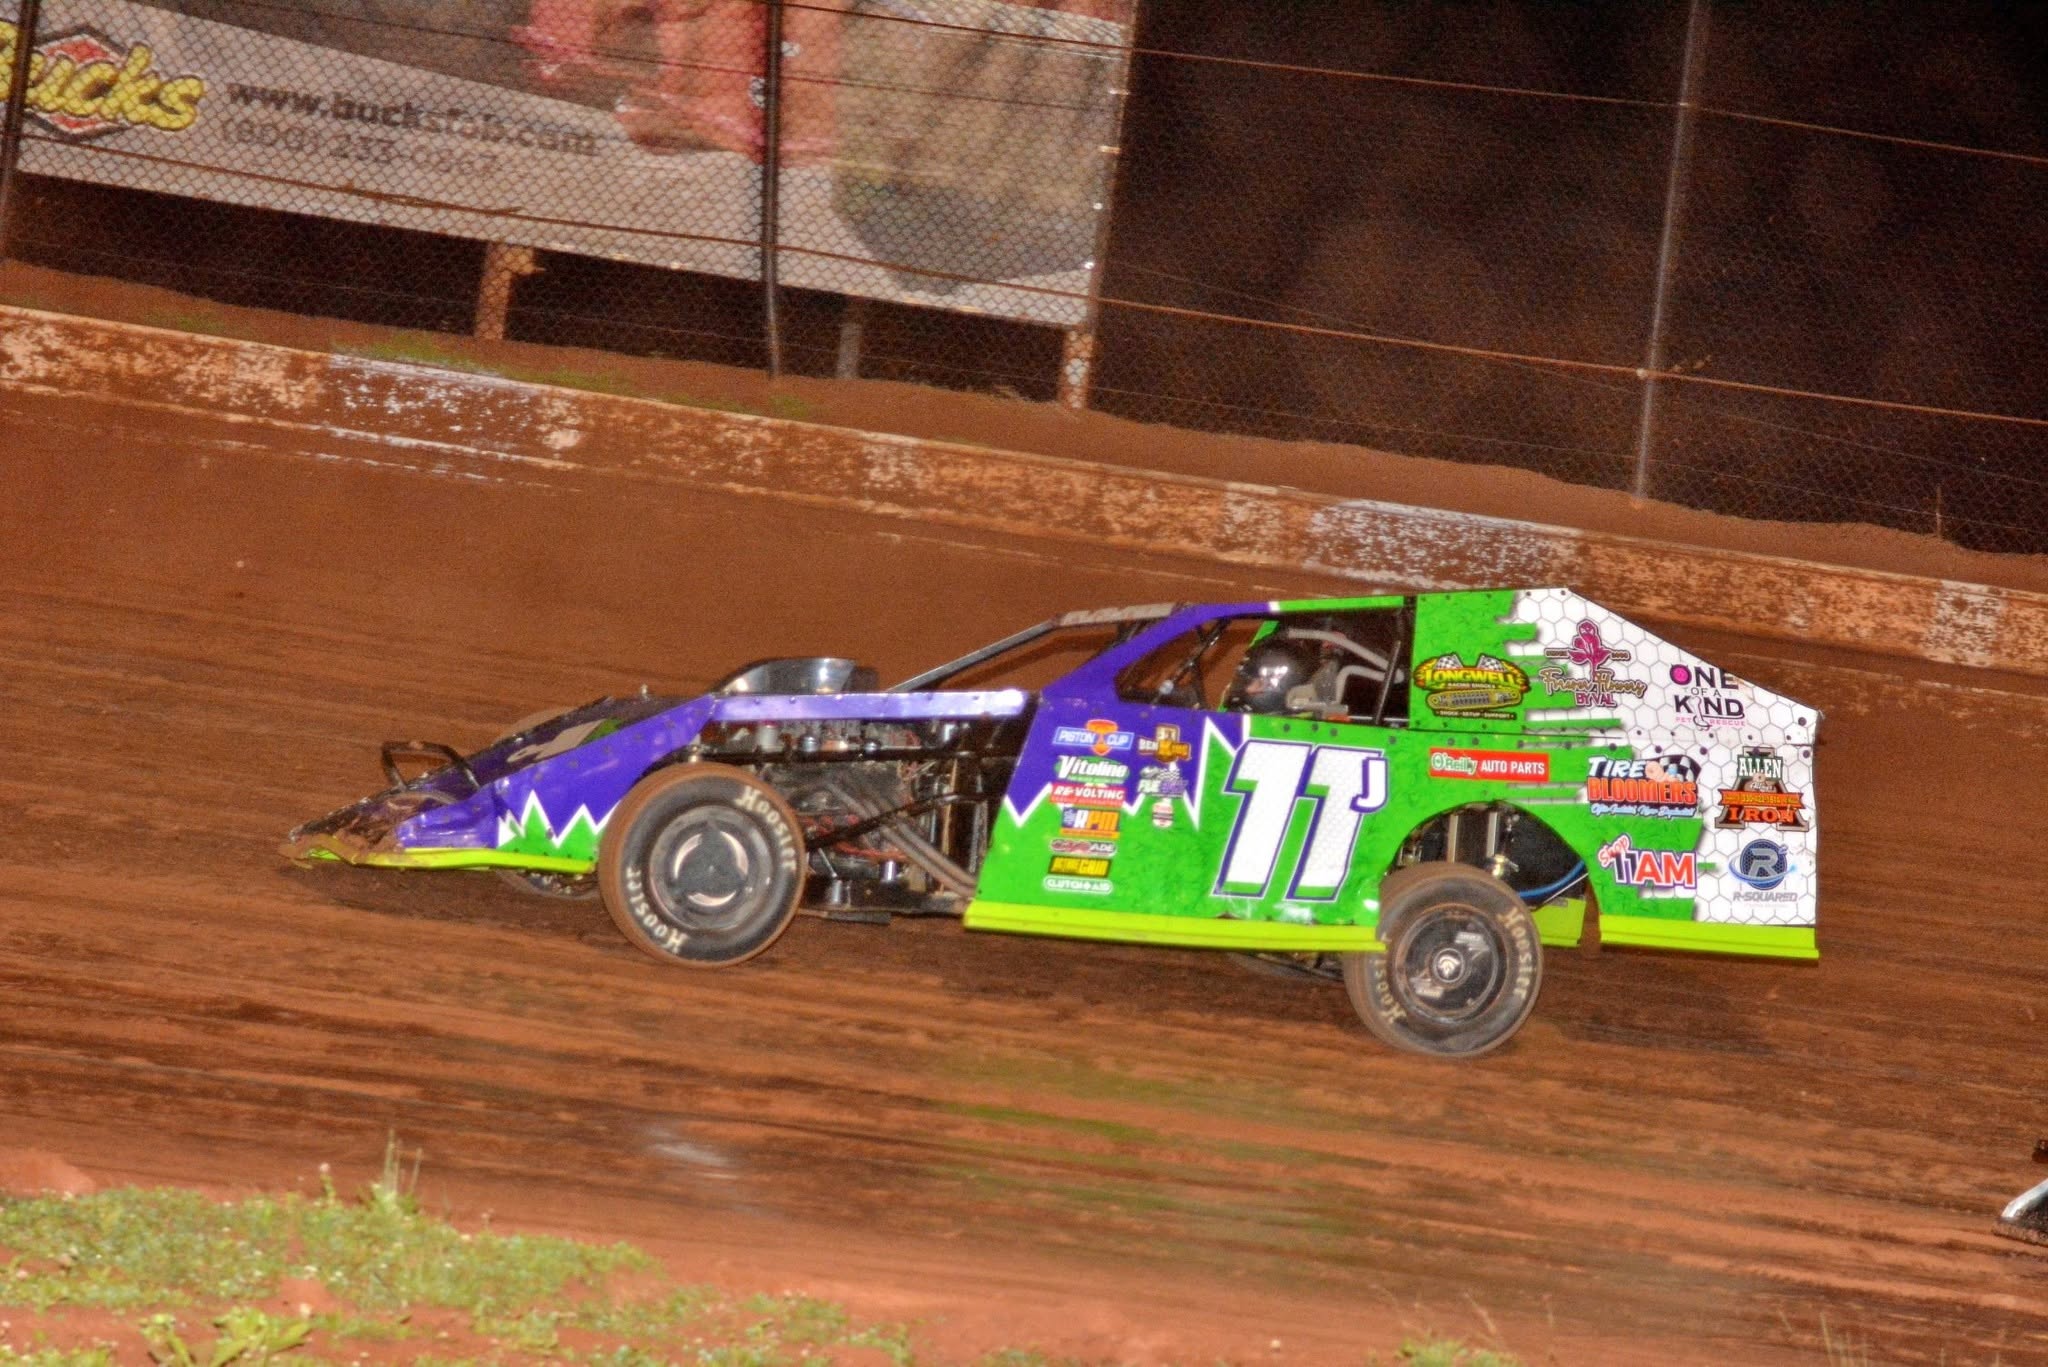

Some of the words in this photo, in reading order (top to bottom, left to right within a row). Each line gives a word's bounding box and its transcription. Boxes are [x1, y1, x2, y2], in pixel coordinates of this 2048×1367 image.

[1425, 669, 1516, 687] LONGWELL
[1669, 664, 1739, 690] ONE
[1691, 686, 1708, 697] OF
[1713, 688, 1722, 698] A
[1058, 730, 1097, 745] PISTON
[1106, 732, 1131, 747] CUP
[1480, 759, 1508, 773] AUTO
[1511, 760, 1545, 775] PARTS
[1588, 756, 1647, 778] TIRE
[1738, 757, 1782, 779] ALLEN
[1587, 776, 1697, 805] BLOOMERS
[1728, 806, 1795, 824] IRON
[1733, 891, 1798, 903] R-SQUARED
[1369, 930, 1408, 1025] Hoosir
